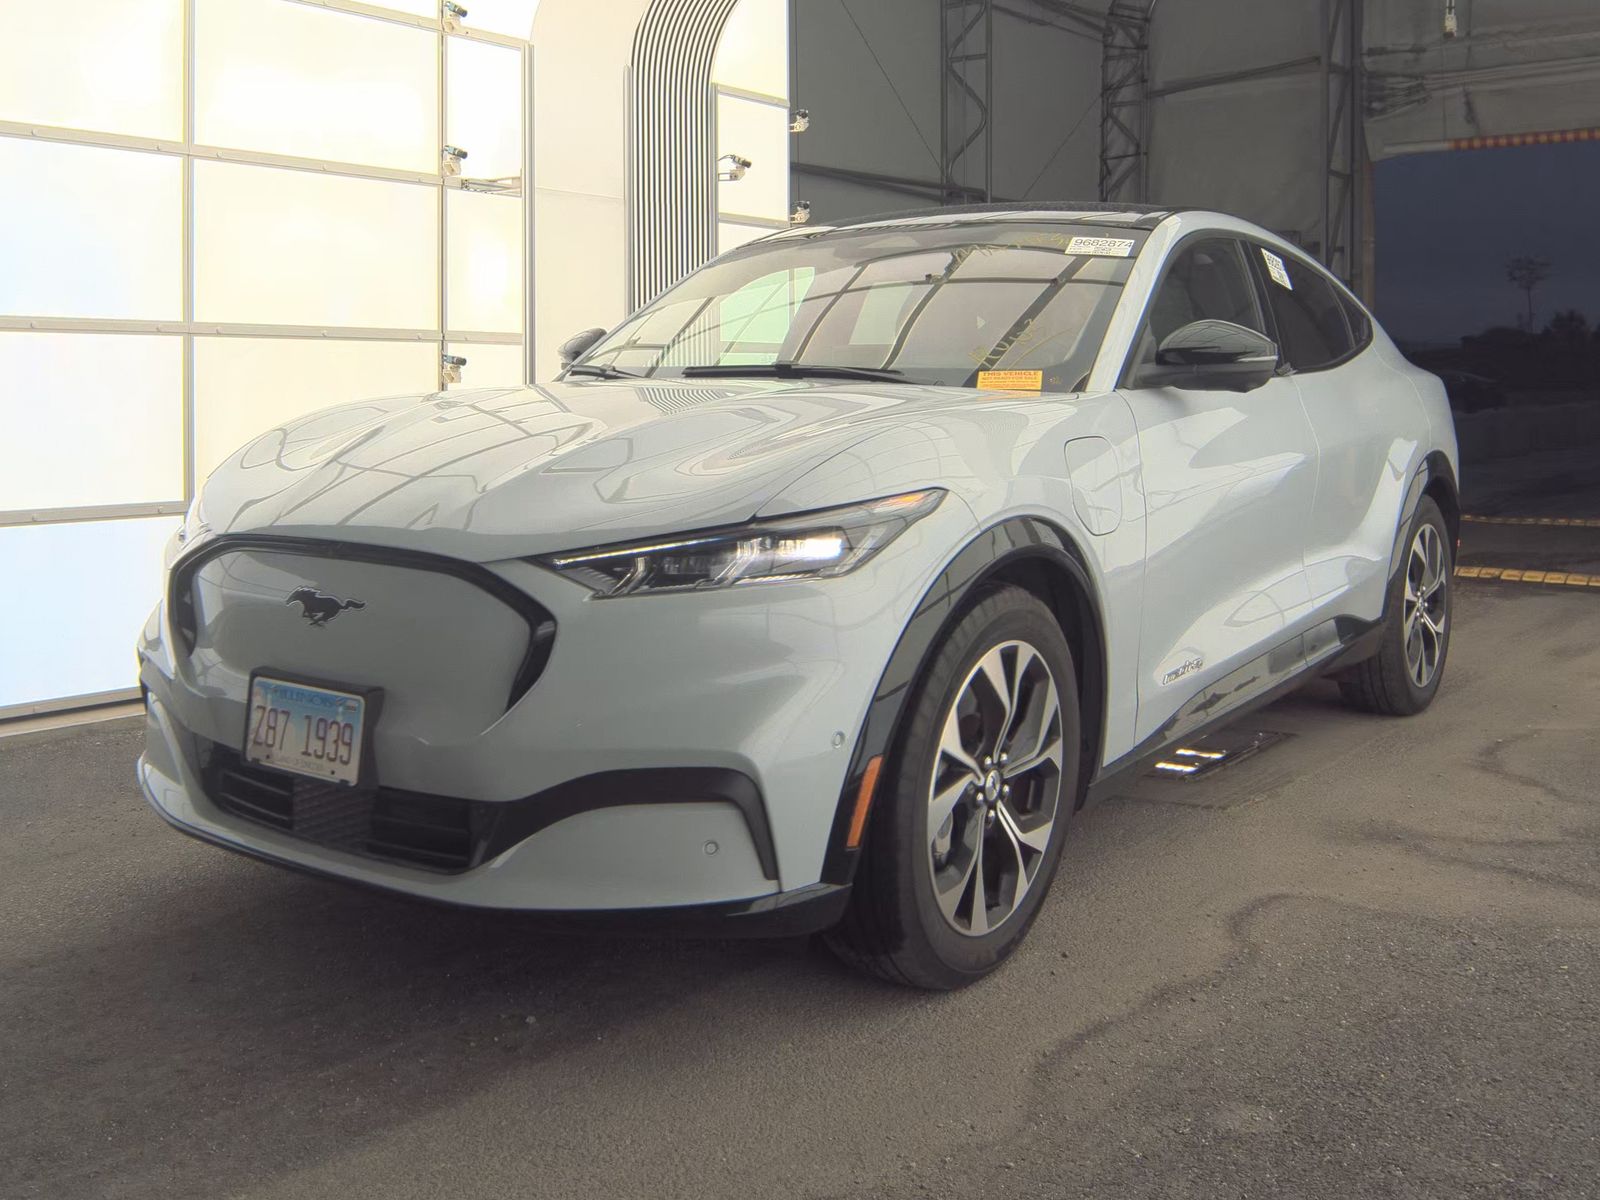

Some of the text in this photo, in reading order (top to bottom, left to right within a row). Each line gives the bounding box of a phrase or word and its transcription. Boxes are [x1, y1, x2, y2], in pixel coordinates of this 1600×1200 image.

[1074, 238, 1133, 248] 9682874
[253, 705, 354, 766] Z87 1939
